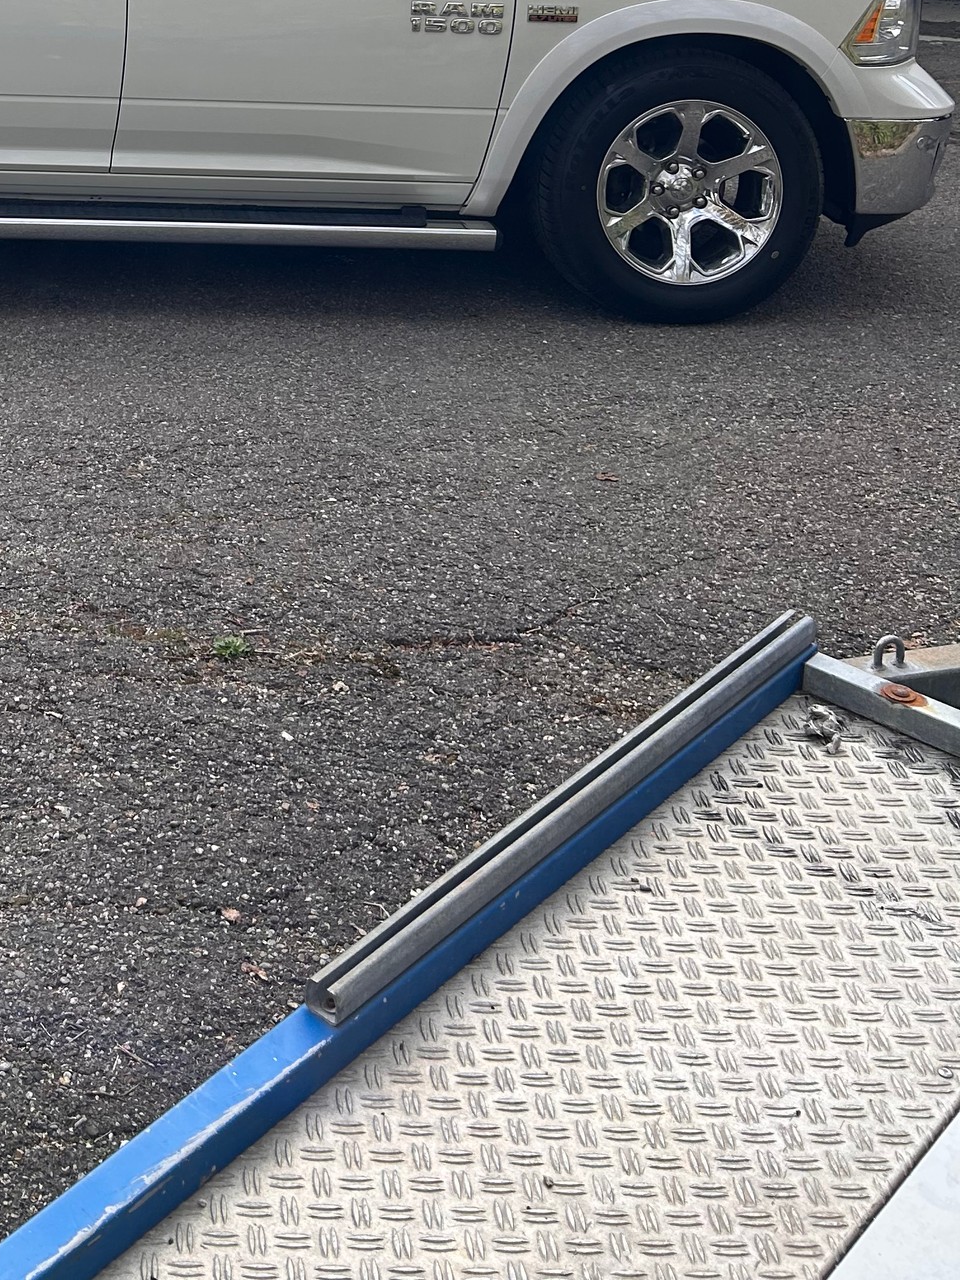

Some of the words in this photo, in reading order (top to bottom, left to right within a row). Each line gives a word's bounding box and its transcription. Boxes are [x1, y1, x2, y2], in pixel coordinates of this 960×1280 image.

[411, 0, 504, 18] RAM
[527, 4, 579, 15] HEMI
[410, 17, 503, 35] 1500
